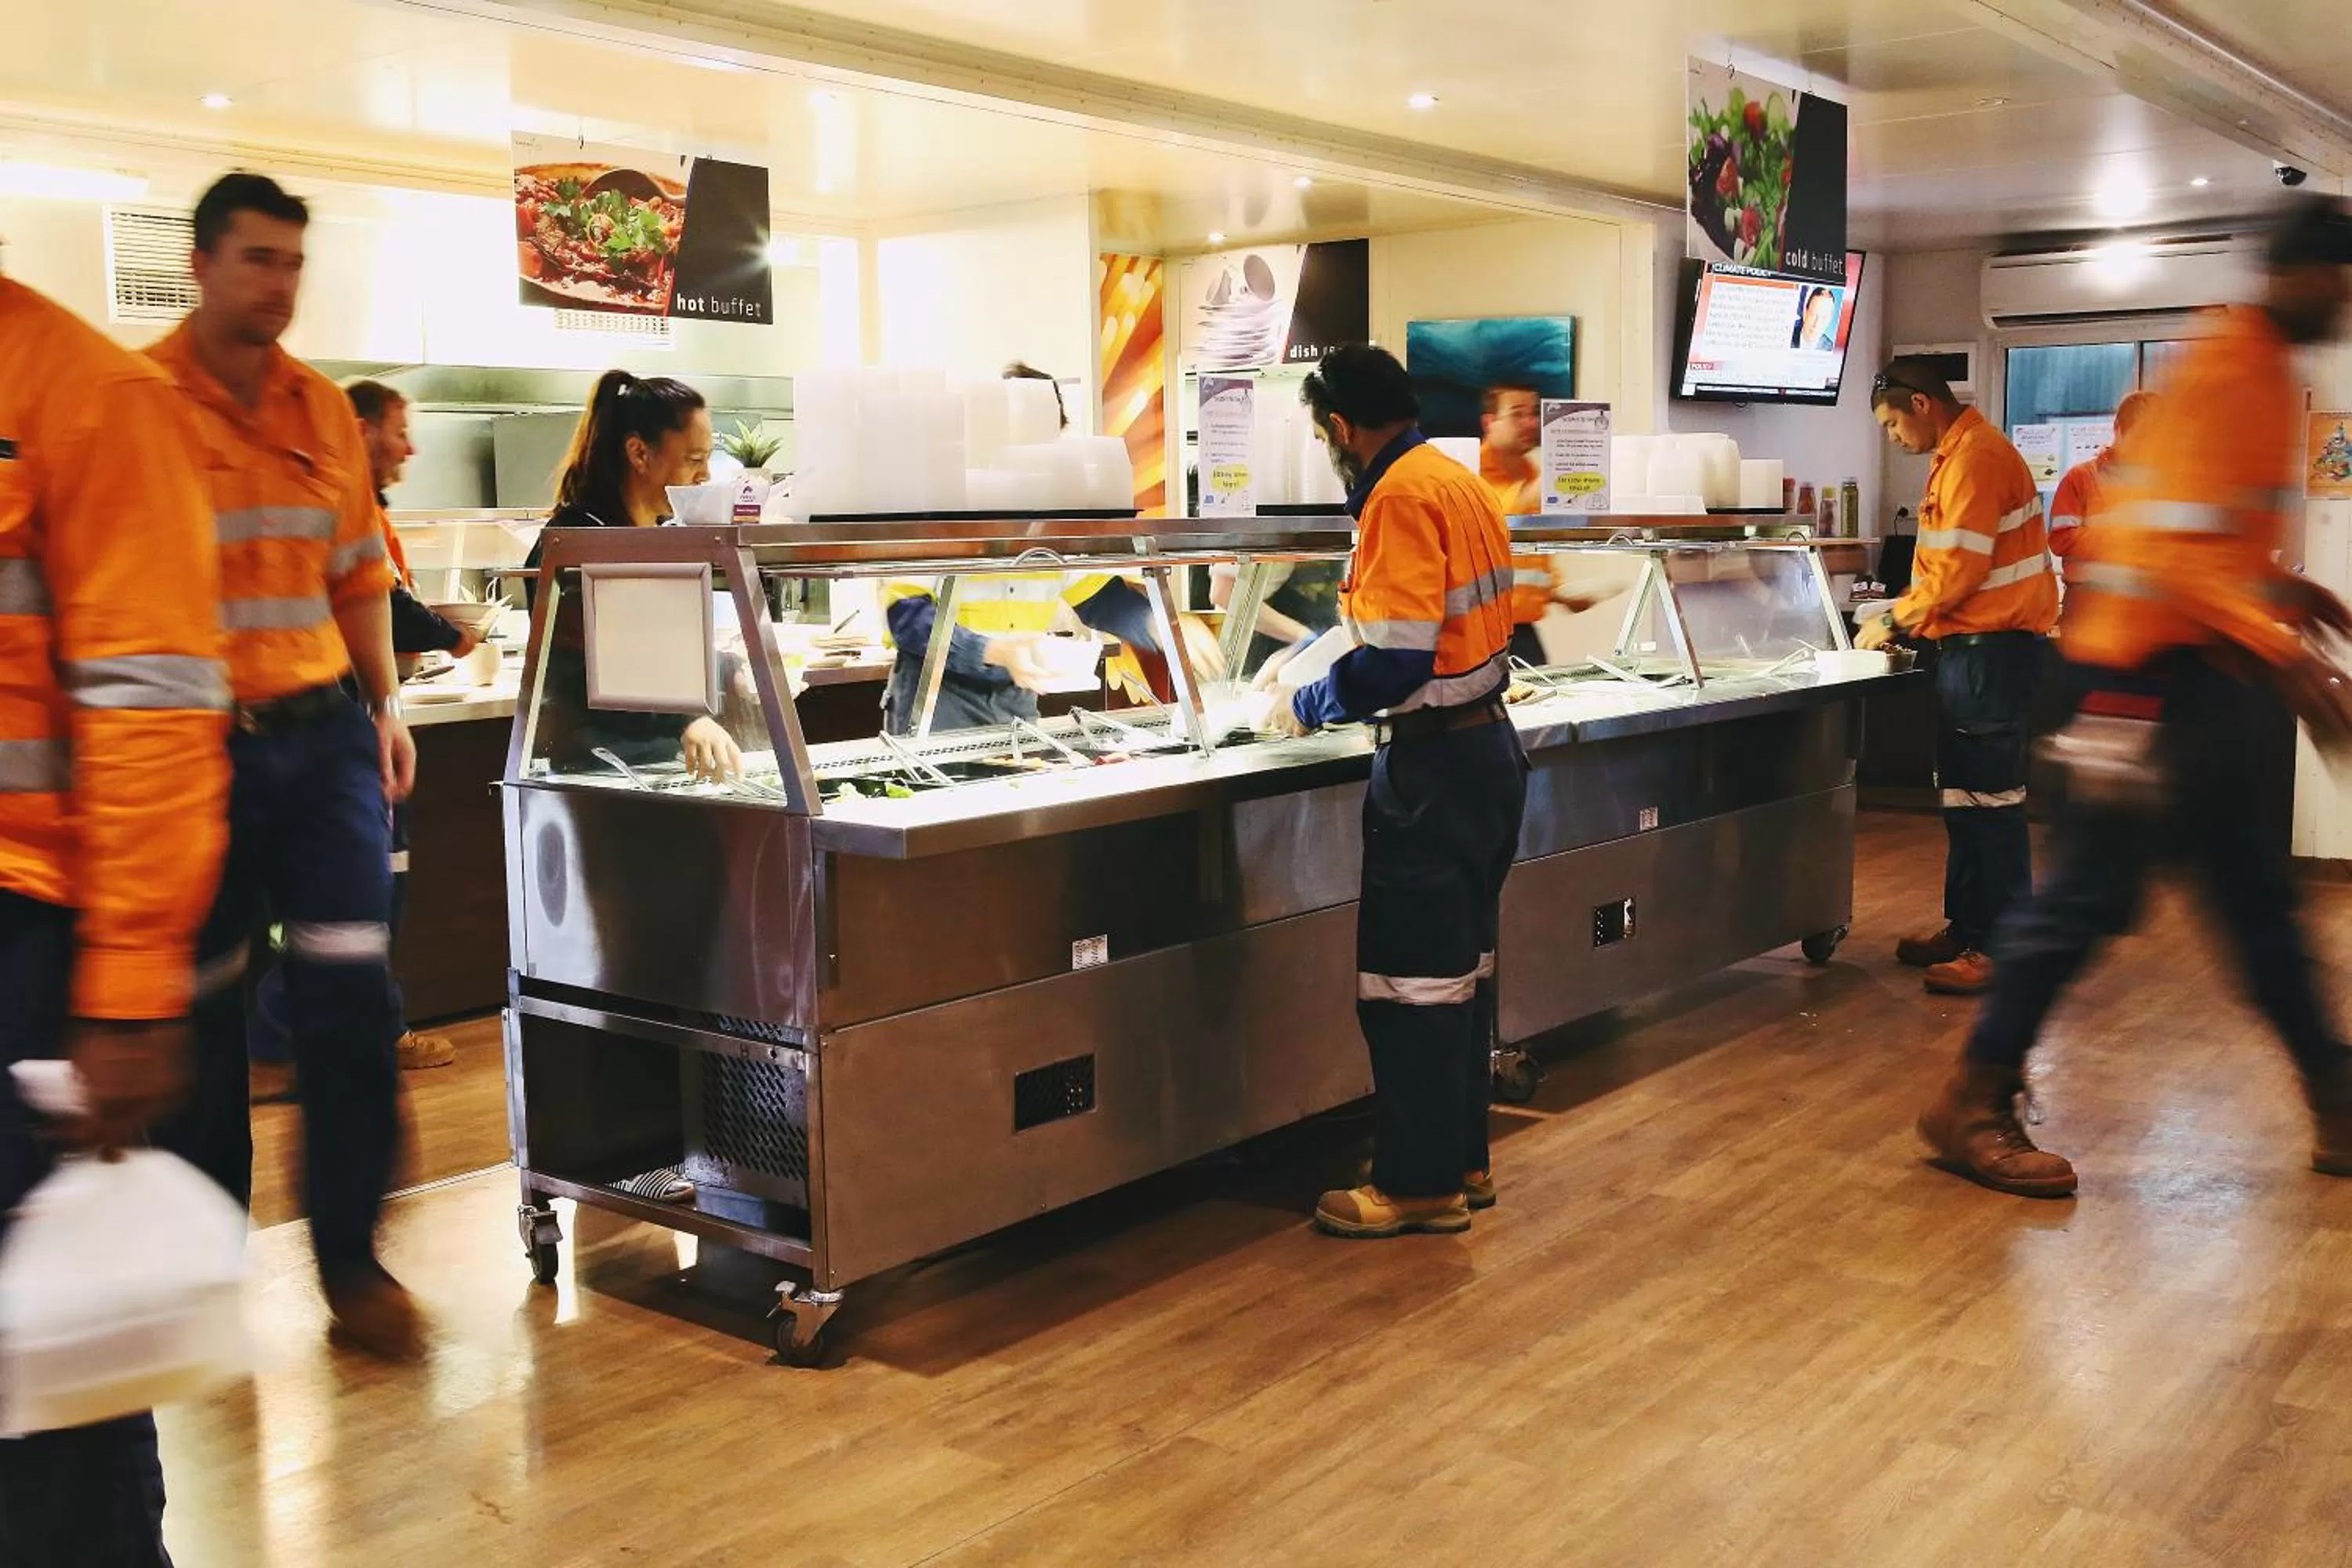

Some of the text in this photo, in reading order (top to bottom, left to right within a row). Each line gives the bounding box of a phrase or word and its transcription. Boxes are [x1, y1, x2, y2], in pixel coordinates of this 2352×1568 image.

[1785, 248, 1843, 275] cold buffet
[677, 292, 761, 318] hot buffet
[1290, 345, 1318, 358] dish
